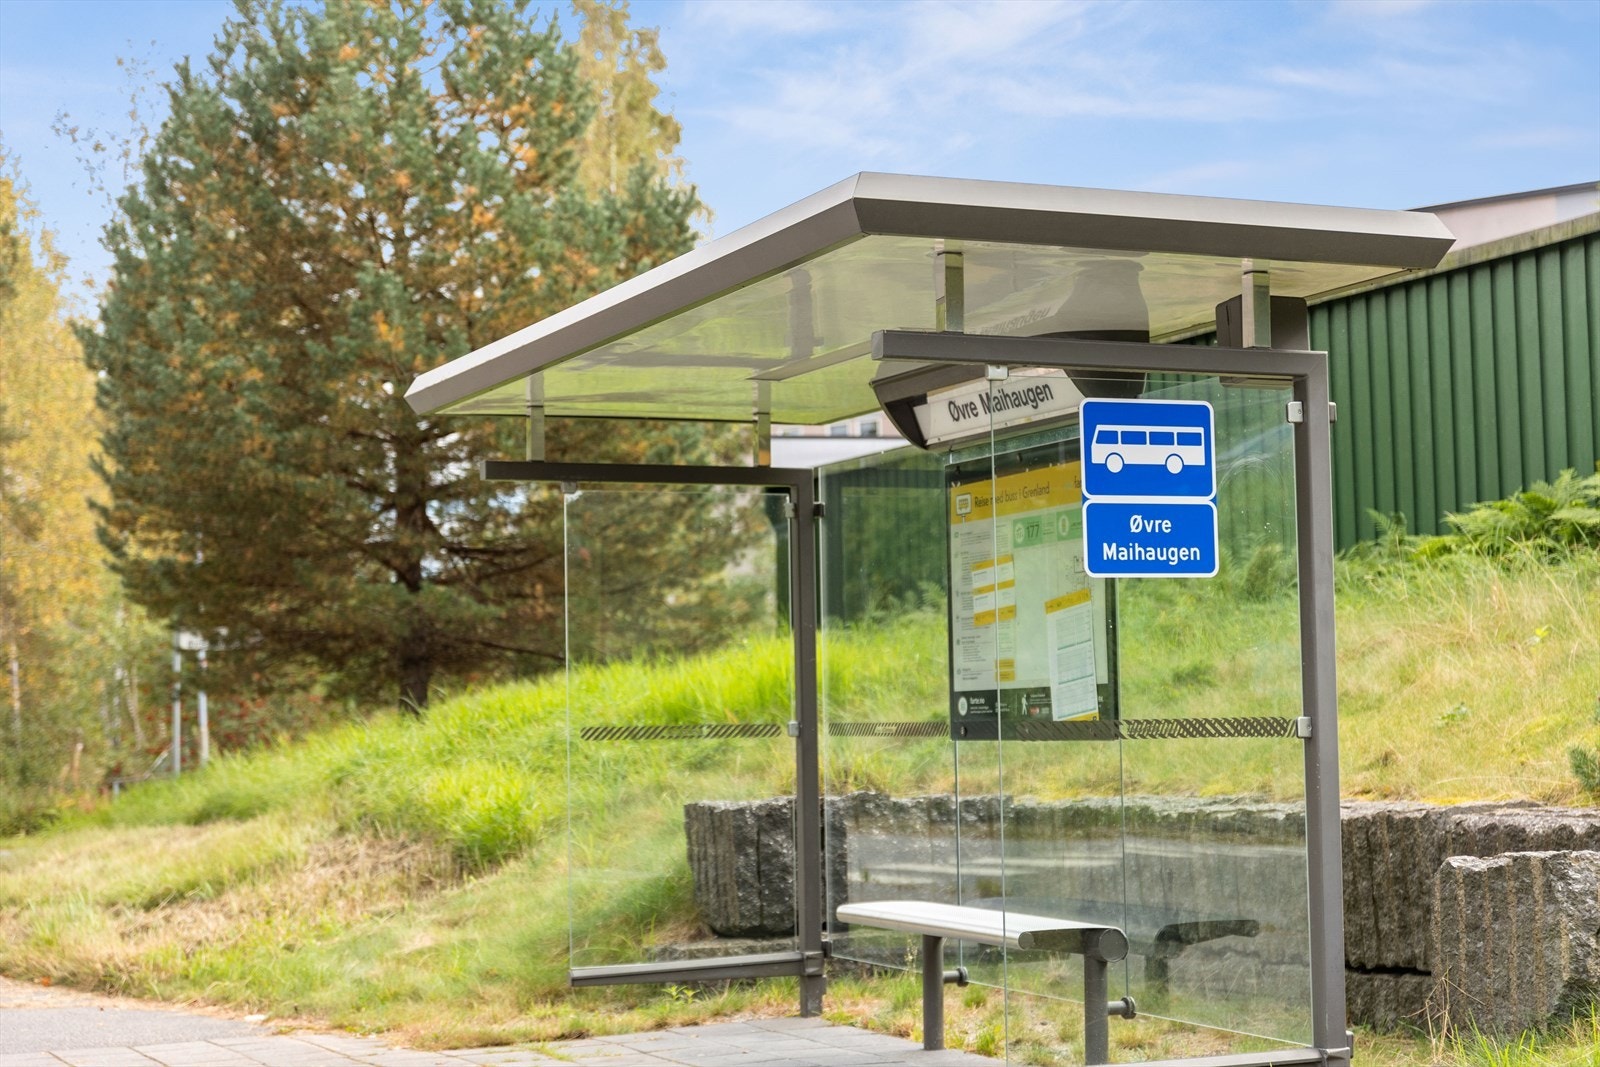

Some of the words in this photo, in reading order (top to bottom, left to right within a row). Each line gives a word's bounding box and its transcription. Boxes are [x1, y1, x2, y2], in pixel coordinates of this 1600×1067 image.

[948, 400, 979, 422] Øvre
[979, 383, 1054, 414] Maihaugen
[974, 496, 989, 508] Reise
[1005, 489, 1018, 502] buss
[1022, 482, 1050, 498] Grenland
[1026, 524, 1040, 538] 177
[1129, 514, 1172, 533] Øvre
[1102, 543, 1201, 566] Maihaugen
